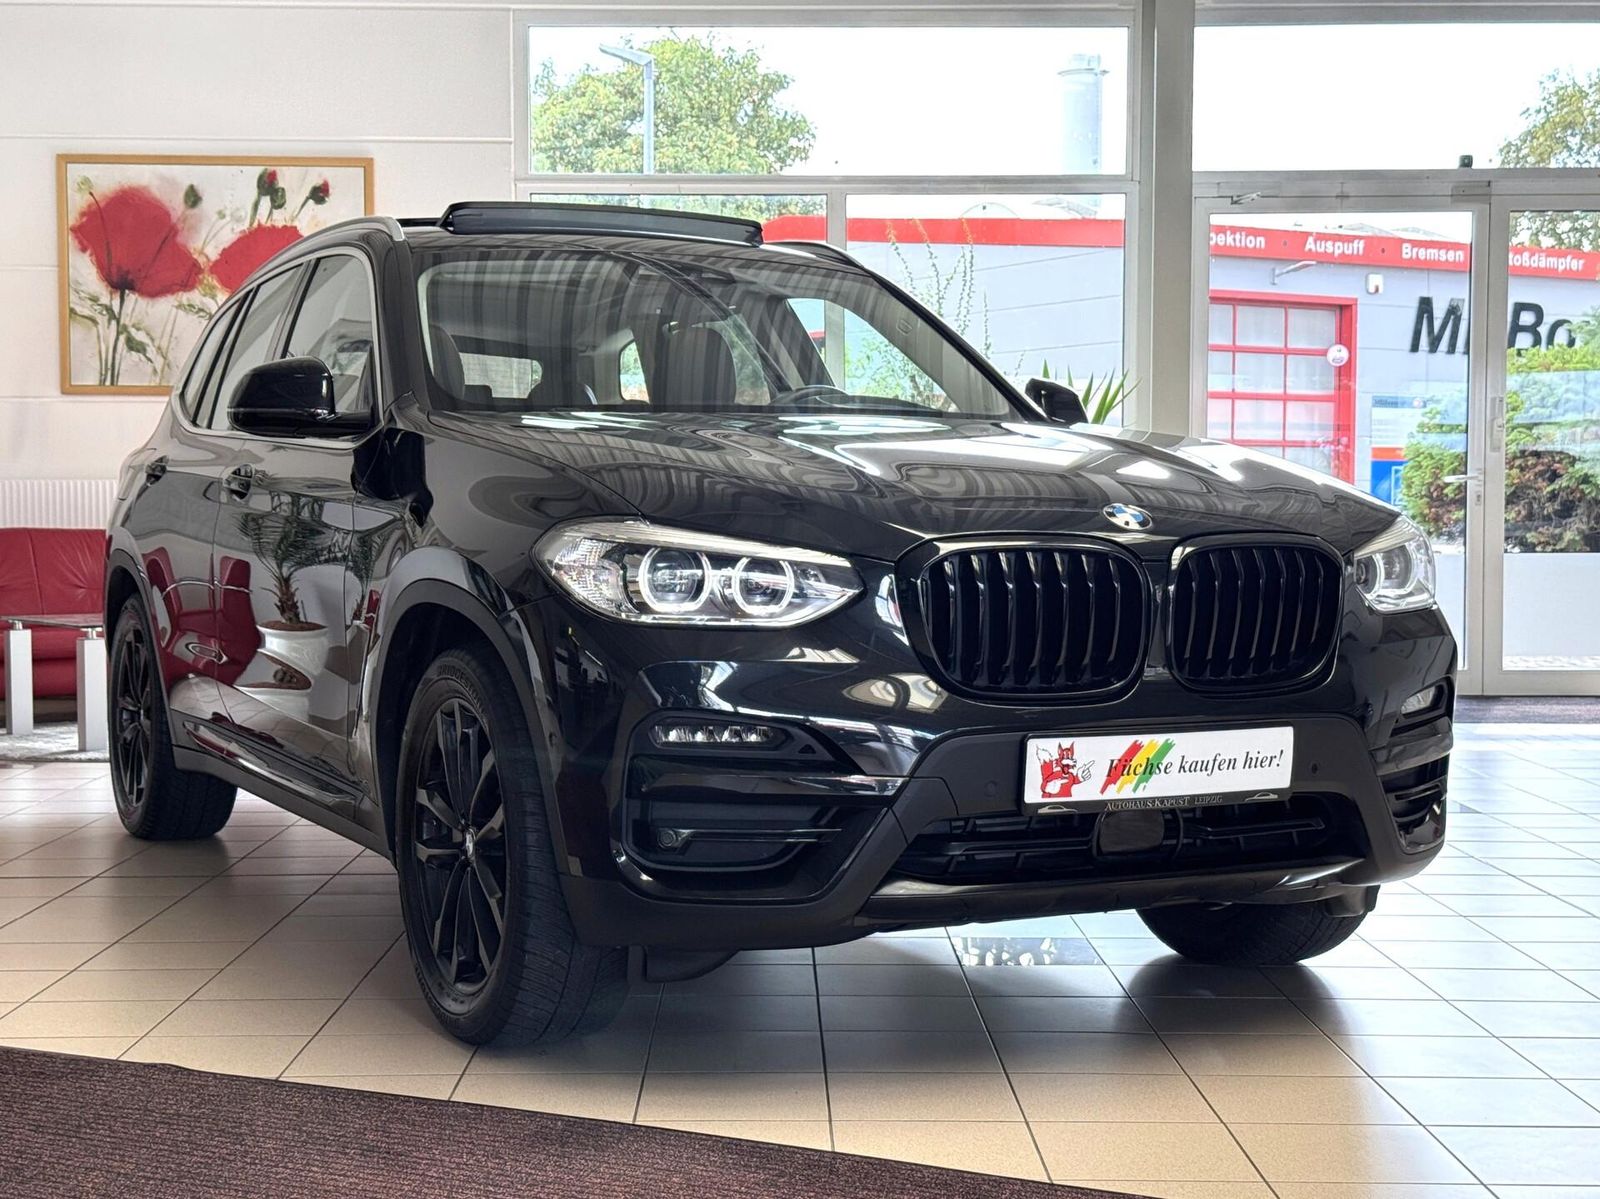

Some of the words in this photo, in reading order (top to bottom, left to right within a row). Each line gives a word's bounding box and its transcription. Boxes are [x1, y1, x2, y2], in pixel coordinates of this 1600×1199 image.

[1304, 235, 1365, 257] Auspuff
[1402, 243, 1464, 262] Bremsen
[1106, 757, 1173, 778] Füchse
[1178, 753, 1237, 777] kaufen
[1242, 749, 1284, 770] hier!
